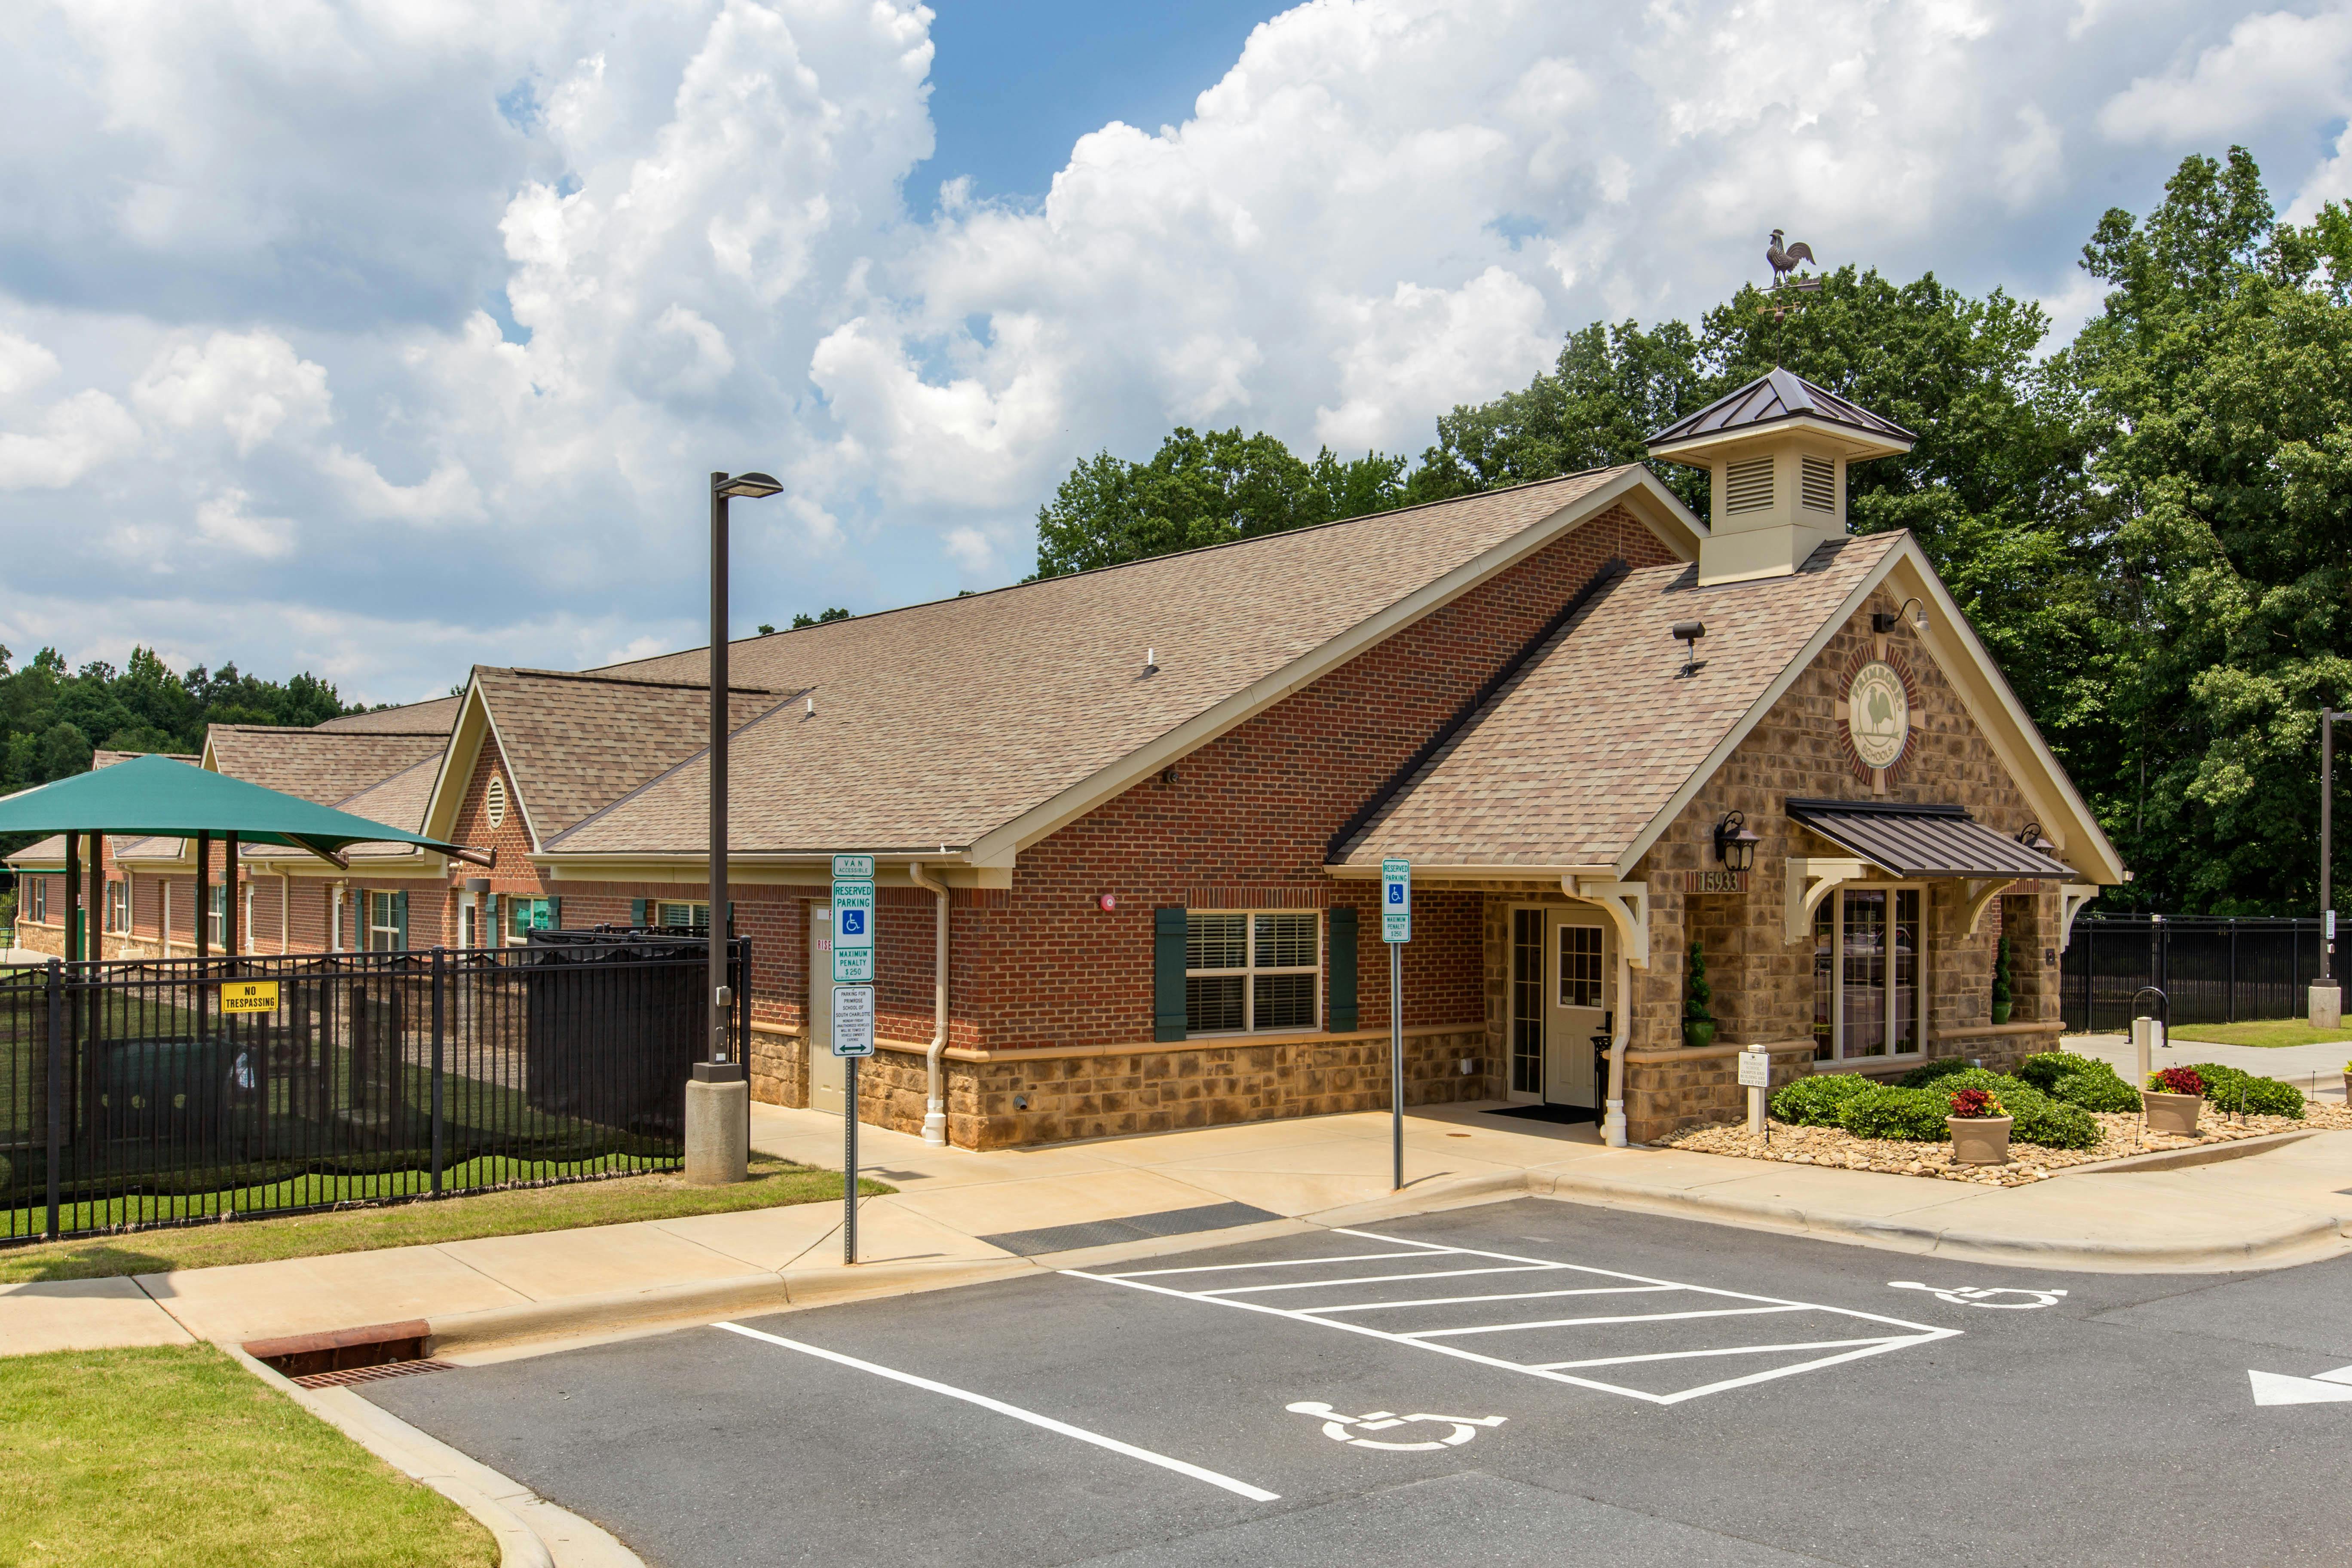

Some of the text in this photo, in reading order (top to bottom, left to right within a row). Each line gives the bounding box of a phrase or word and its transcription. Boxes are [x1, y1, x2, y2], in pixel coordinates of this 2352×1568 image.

[1852, 667, 1902, 703] PRIMROSE
[1862, 744, 1893, 761] SCHOOLS
[1700, 872, 1738, 892] 15933
[836, 887, 872, 895] RESERVED
[837, 898, 870, 907] PARKING
[245, 986, 256, 995] NO
[226, 997, 274, 1008] TRESPASSING
